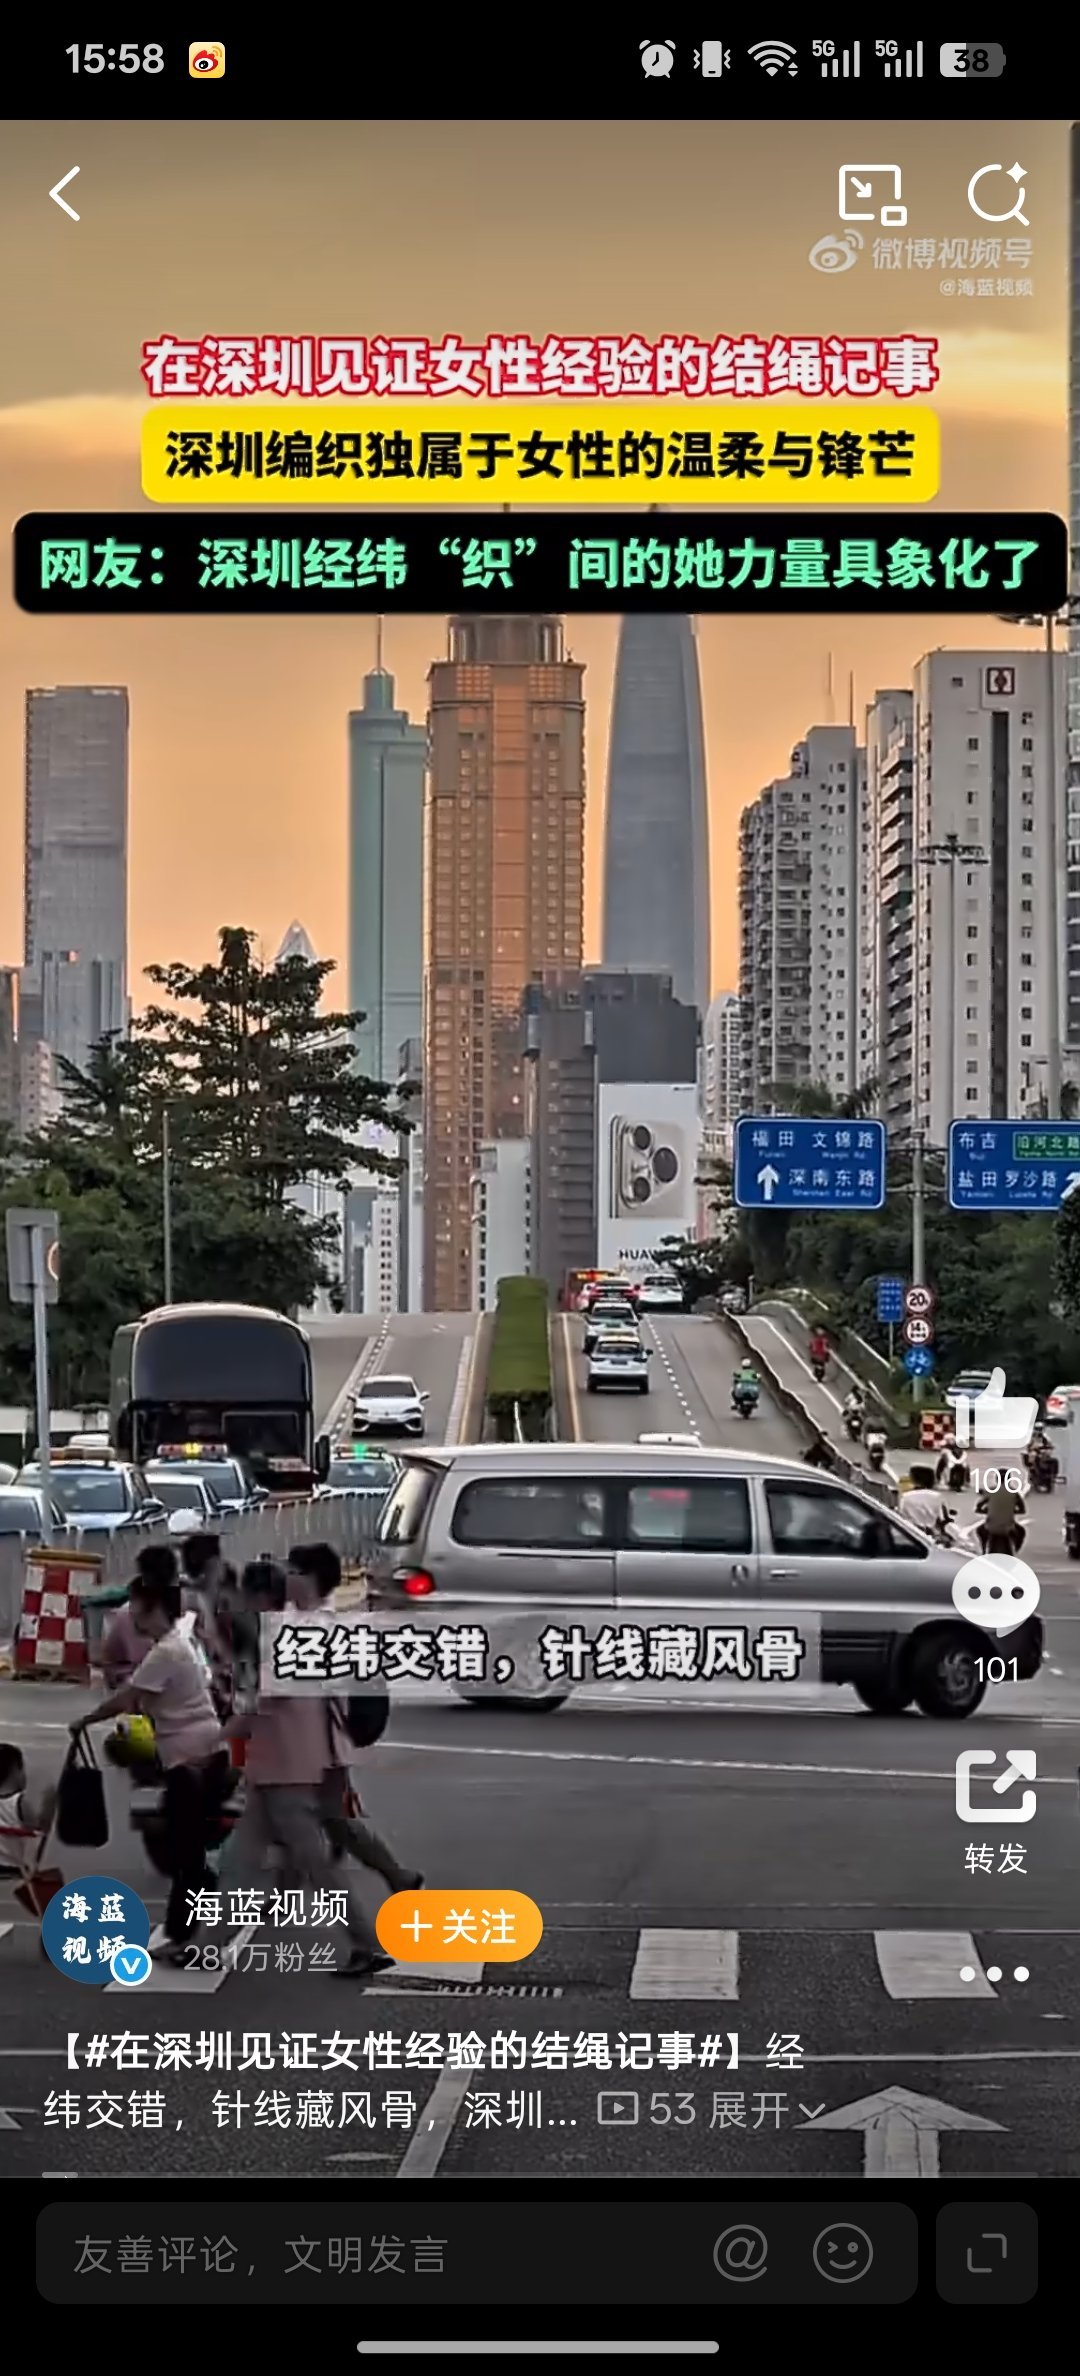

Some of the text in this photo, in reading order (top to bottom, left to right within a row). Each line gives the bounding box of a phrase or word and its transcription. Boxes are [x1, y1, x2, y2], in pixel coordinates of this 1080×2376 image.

[959, 1132, 997, 1150] 布吉
[788, 1168, 875, 1188] 深南东路
[958, 1170, 998, 1189] 盐田
